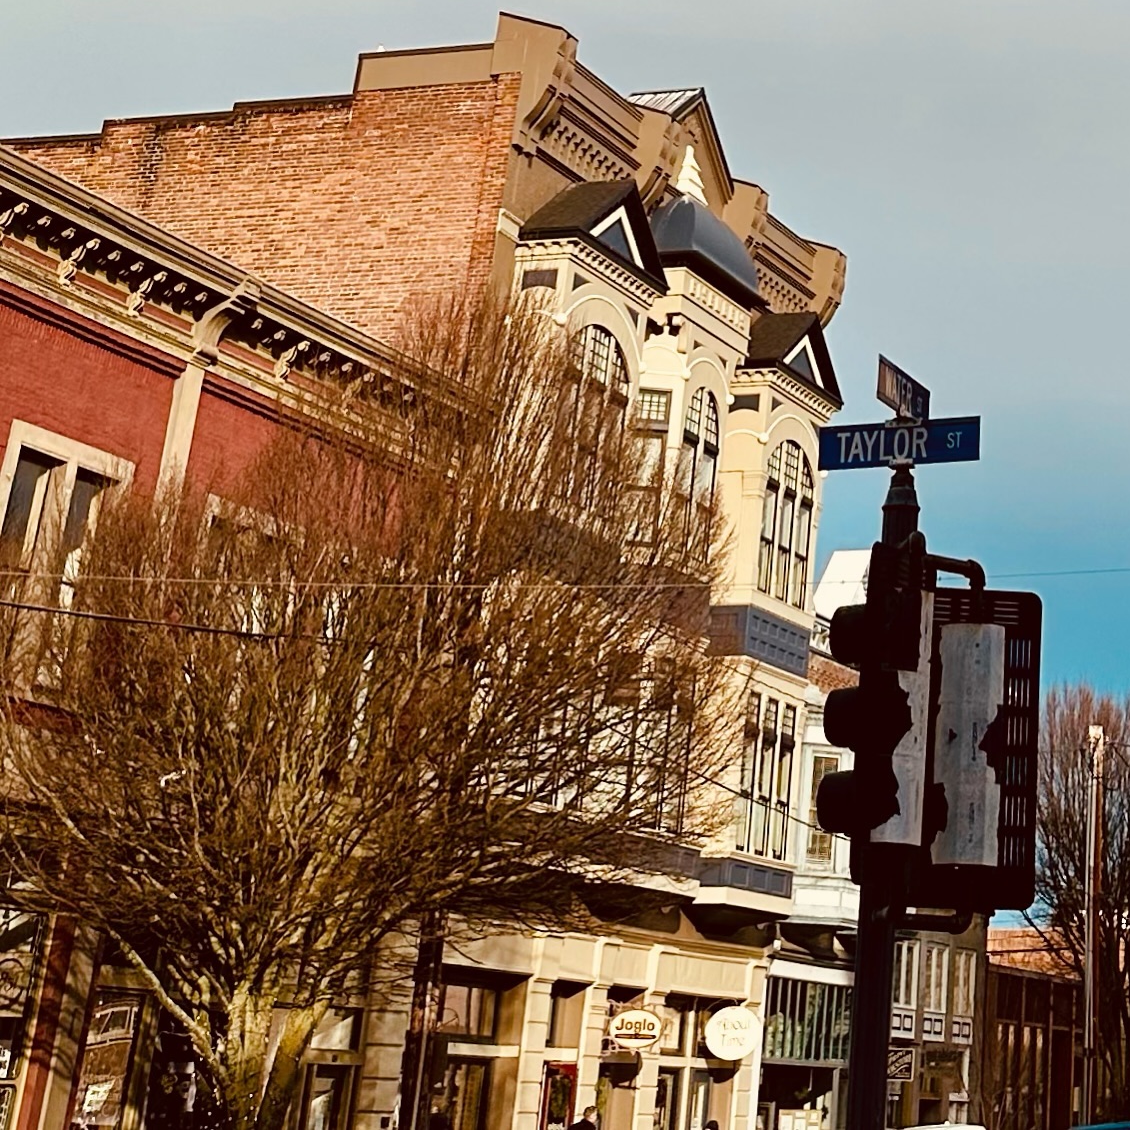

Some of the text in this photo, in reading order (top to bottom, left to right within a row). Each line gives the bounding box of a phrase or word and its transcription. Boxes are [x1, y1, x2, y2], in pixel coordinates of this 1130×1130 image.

[837, 427, 963, 463] TAYLOR ST
[616, 1019, 655, 1033] Joglo
